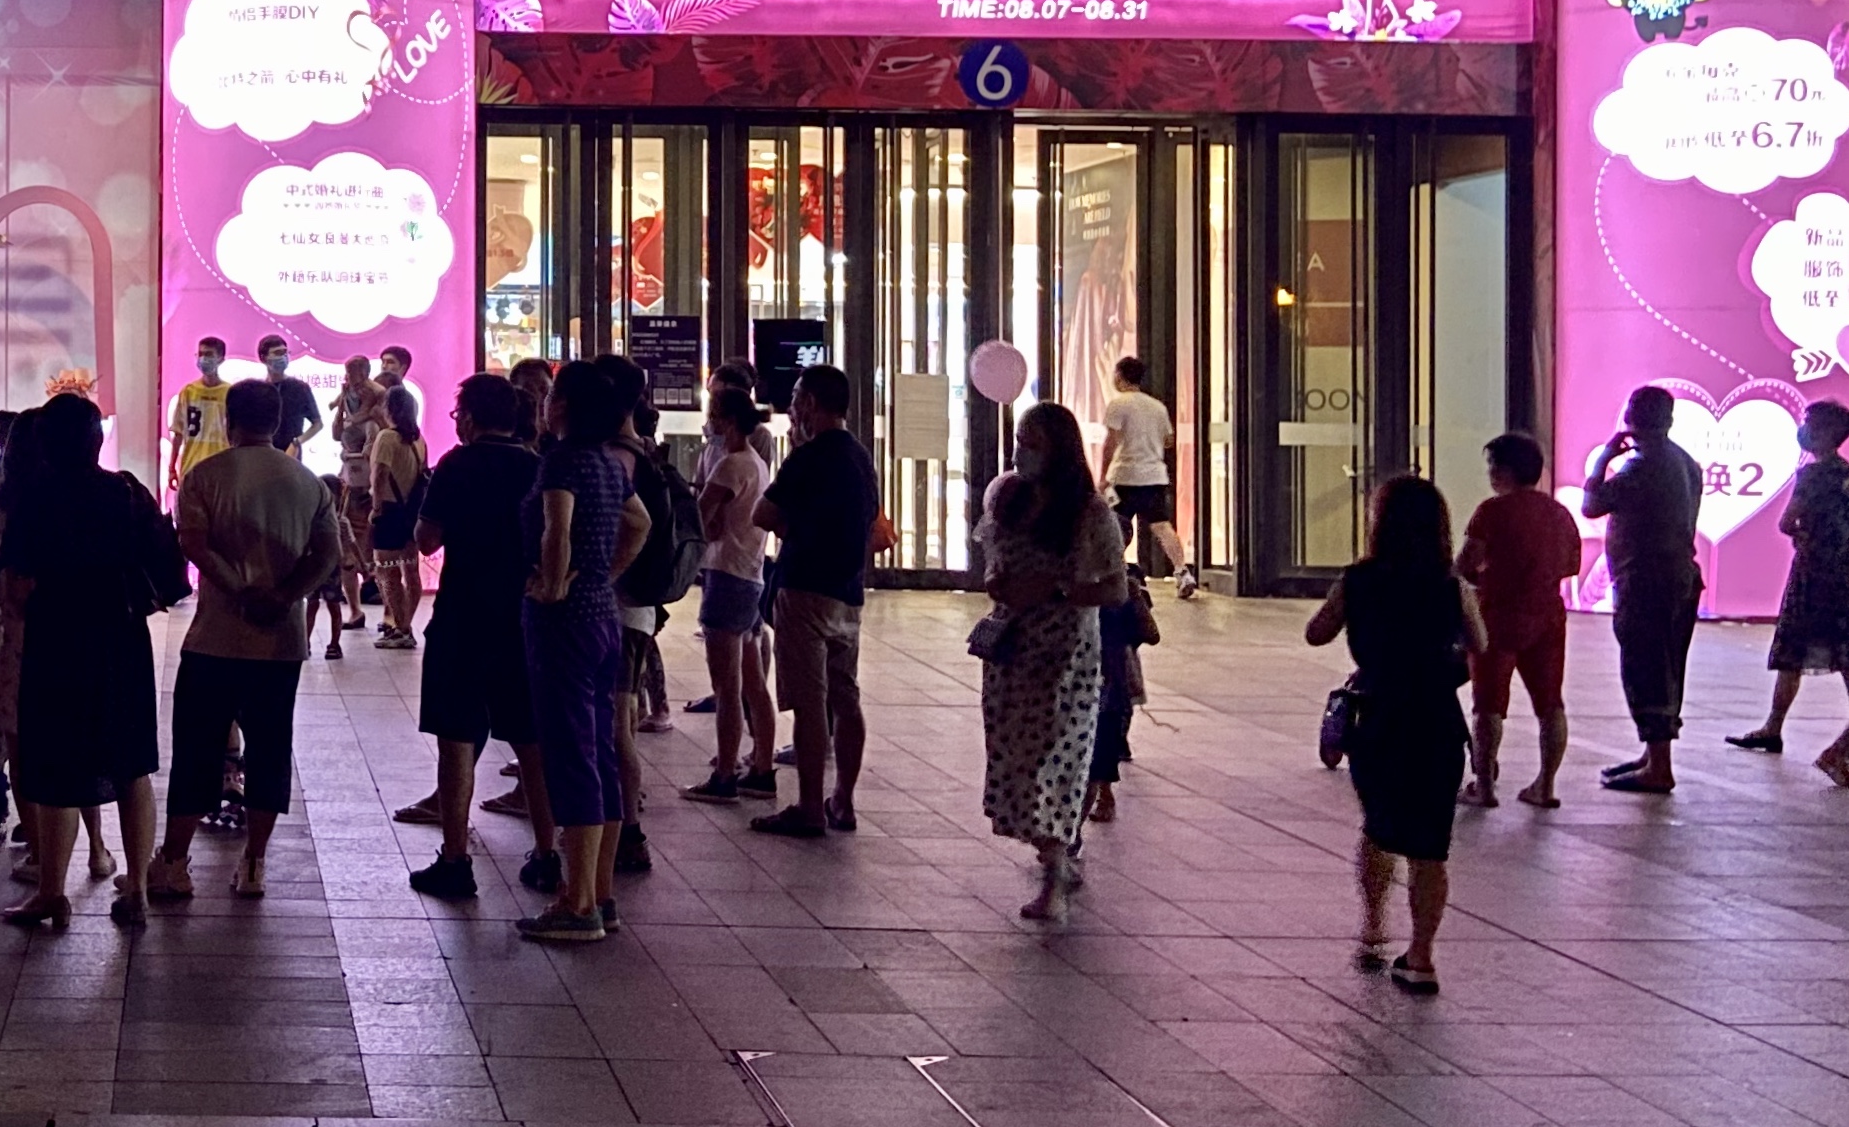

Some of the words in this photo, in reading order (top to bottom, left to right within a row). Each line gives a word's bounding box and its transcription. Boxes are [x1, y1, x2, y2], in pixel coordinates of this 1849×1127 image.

[392, 8, 454, 85] LOVE
[975, 44, 1013, 101] 6
[187, 405, 202, 437] B
